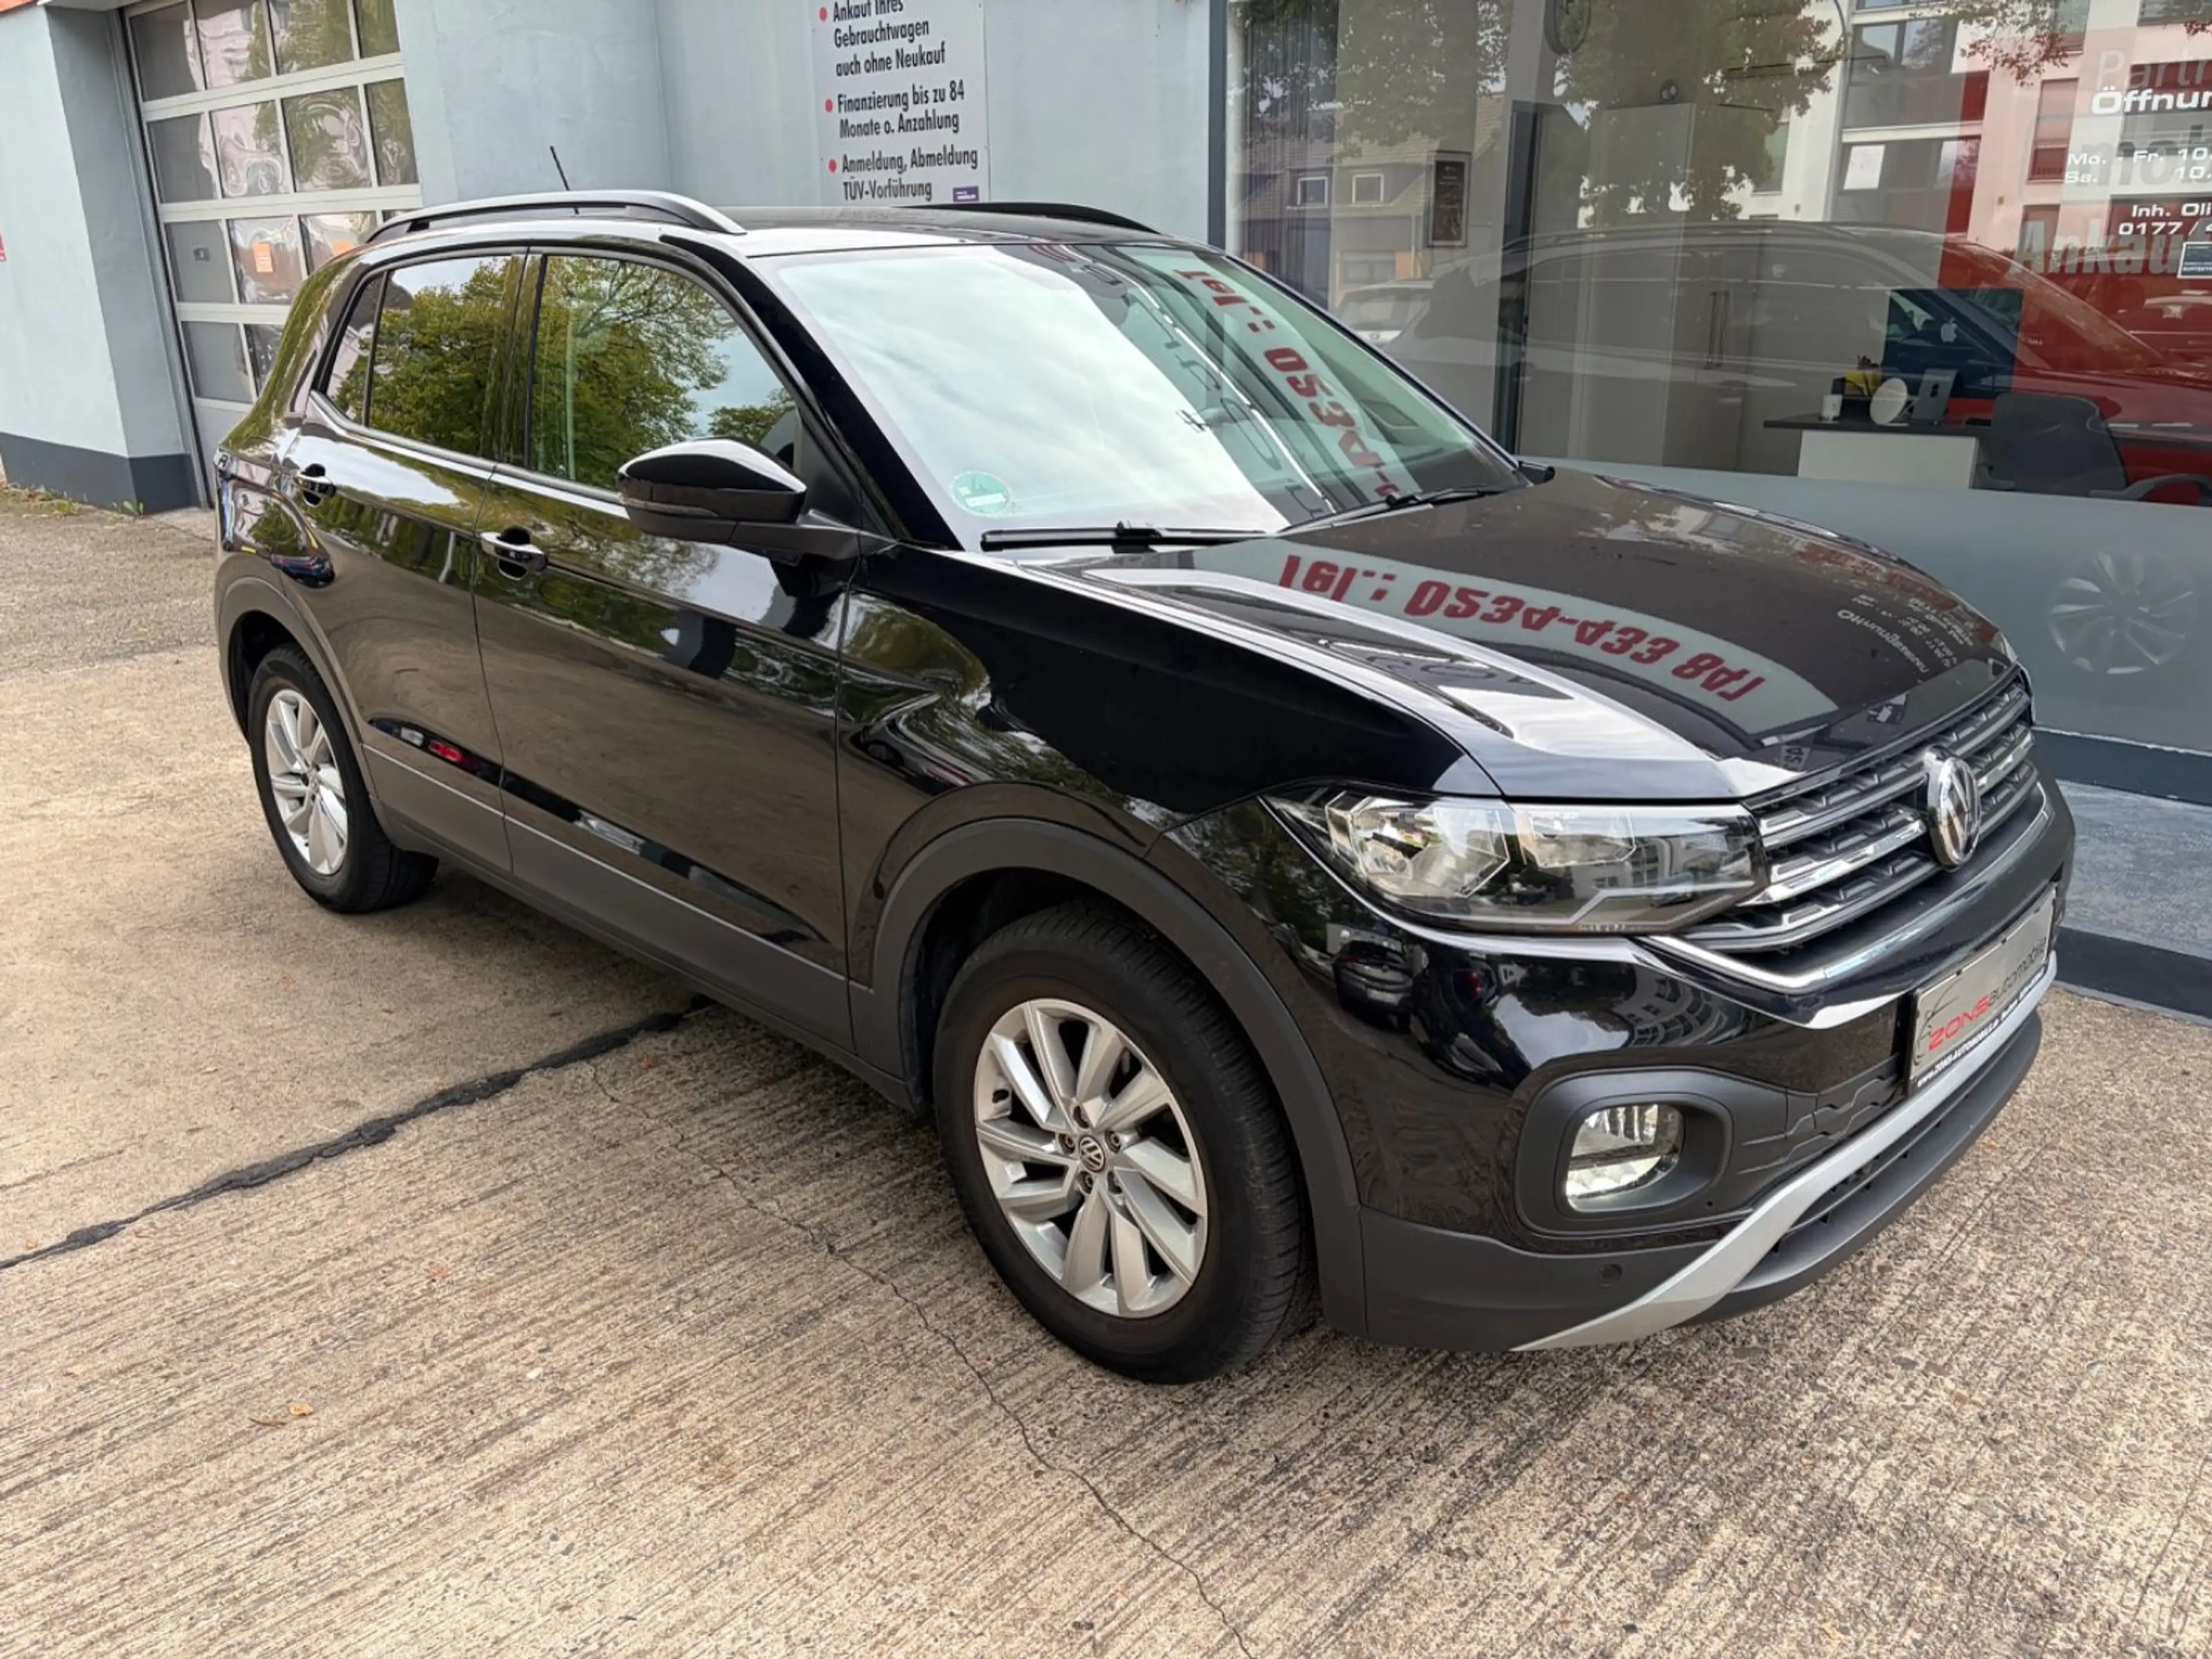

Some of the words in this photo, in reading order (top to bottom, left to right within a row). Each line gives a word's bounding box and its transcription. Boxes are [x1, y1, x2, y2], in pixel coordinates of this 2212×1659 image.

[835, 20, 929, 48] Gebrauchtwagen
[836, 54, 861, 77] auch
[864, 51, 892, 74] ohne
[896, 41, 945, 69] Neukauf
[838, 90, 908, 113] Finanzierung
[912, 84, 929, 105] bis
[933, 88, 946, 103] zu
[949, 79, 964, 101] 84
[839, 118, 880, 139] Monate
[884, 120, 895, 134] o.
[898, 108, 959, 134] Anzahlung
[842, 150, 907, 175] Anmeldung,
[911, 144, 978, 169] Abmeldung
[2068, 153, 2107, 165] Mo.
[2133, 150, 2164, 163] Fr.
[843, 175, 932, 202] TÜV-Vorführung
[2066, 171, 2098, 183] Sa.
[2132, 203, 2171, 218] Inh.
[2118, 221, 2183, 235] 0177
